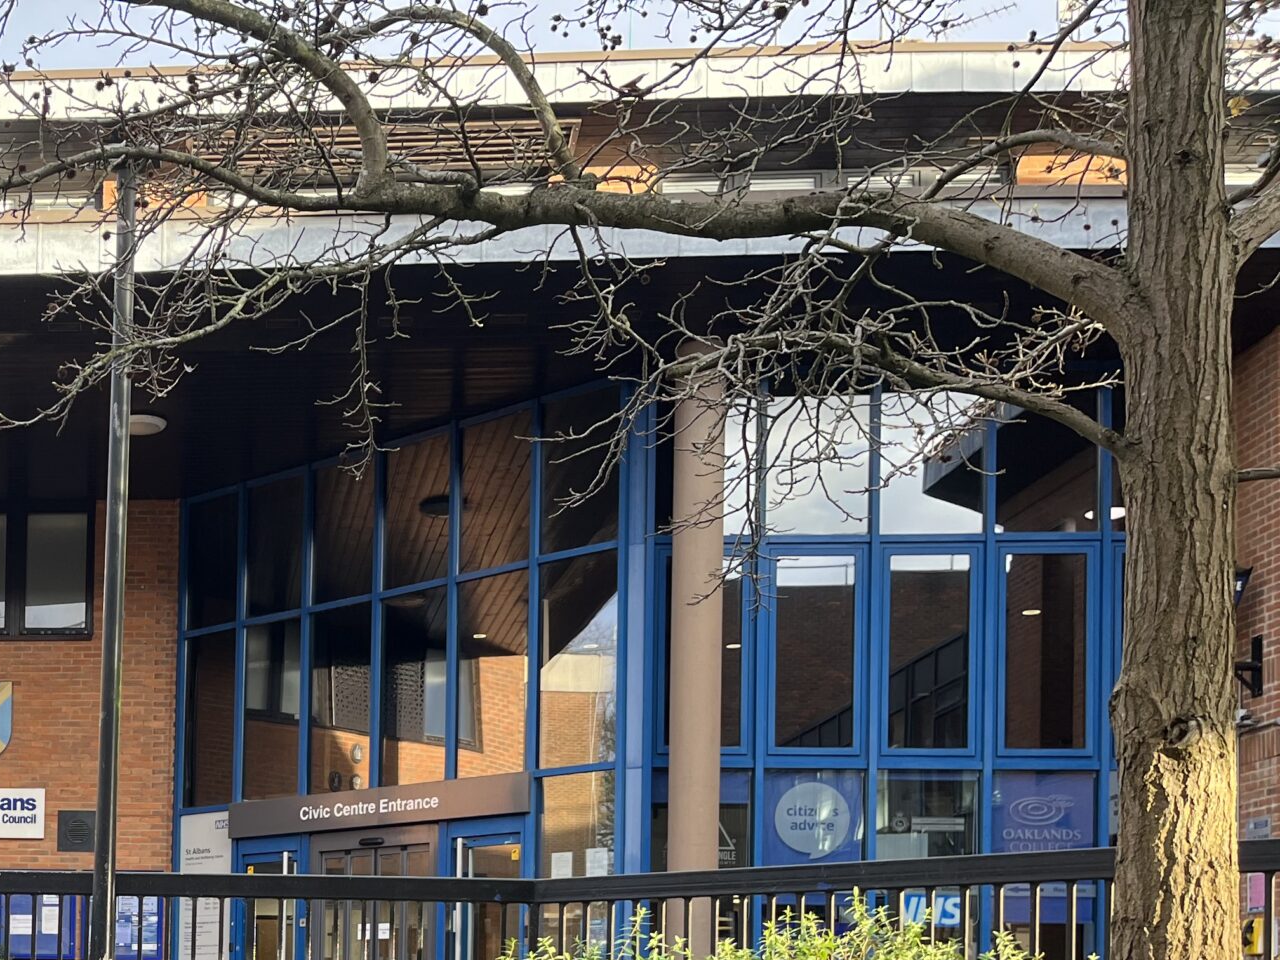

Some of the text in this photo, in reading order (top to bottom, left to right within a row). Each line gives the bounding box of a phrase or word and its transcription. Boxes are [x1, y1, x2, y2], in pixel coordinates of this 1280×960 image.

[300, 796, 439, 820] Civic Centre Entrance
[2, 813, 37, 824] Council
[1002, 828, 1082, 841] OAKLANDS
[903, 896, 960, 926] NHS
